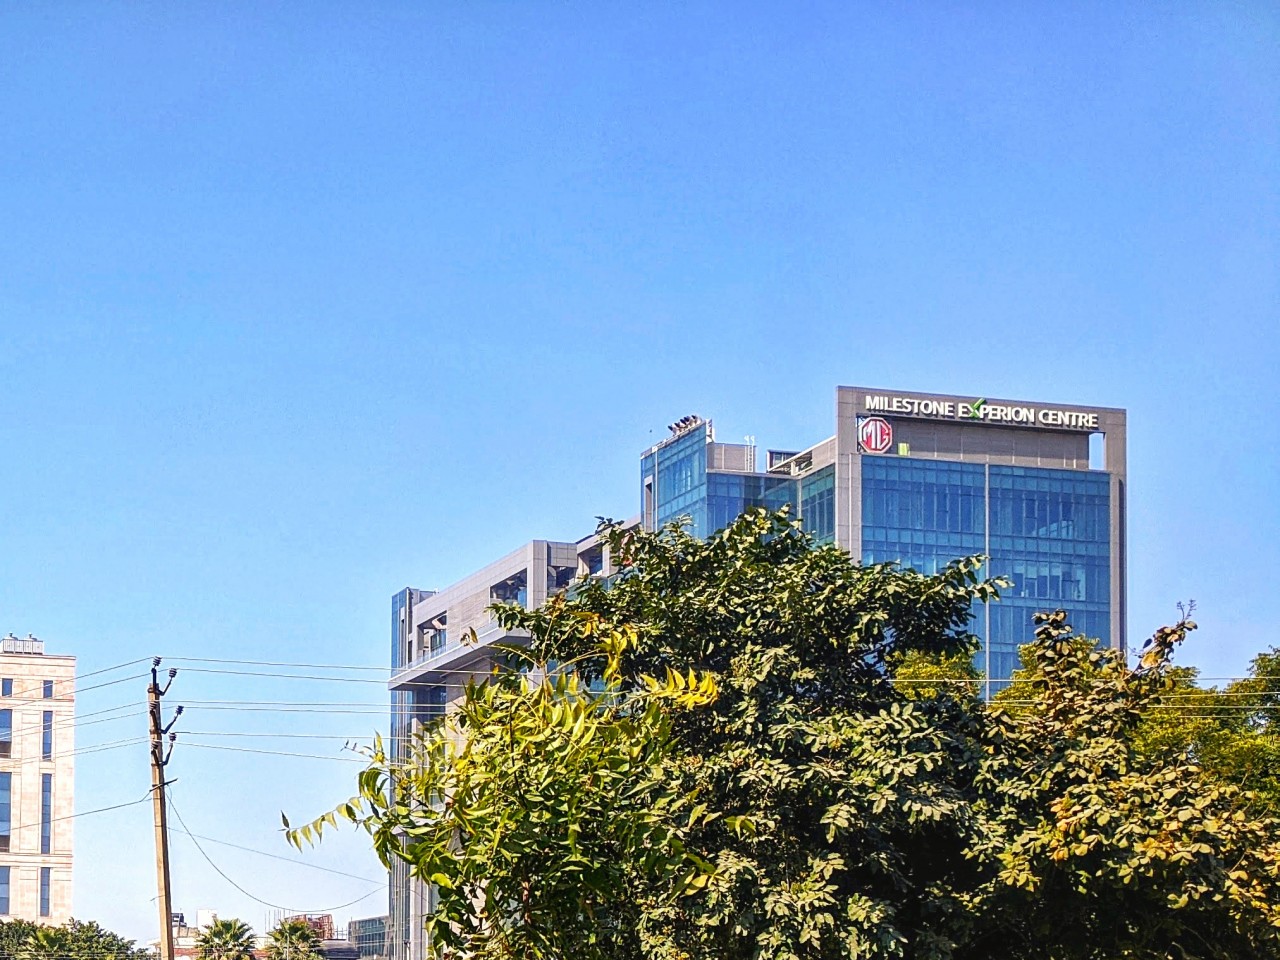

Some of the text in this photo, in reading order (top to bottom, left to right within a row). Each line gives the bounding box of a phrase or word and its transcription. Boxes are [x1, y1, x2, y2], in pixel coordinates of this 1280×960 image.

[865, 395, 1099, 427] MILESTONE EXPERION CENTRE
[862, 420, 889, 450] MG
